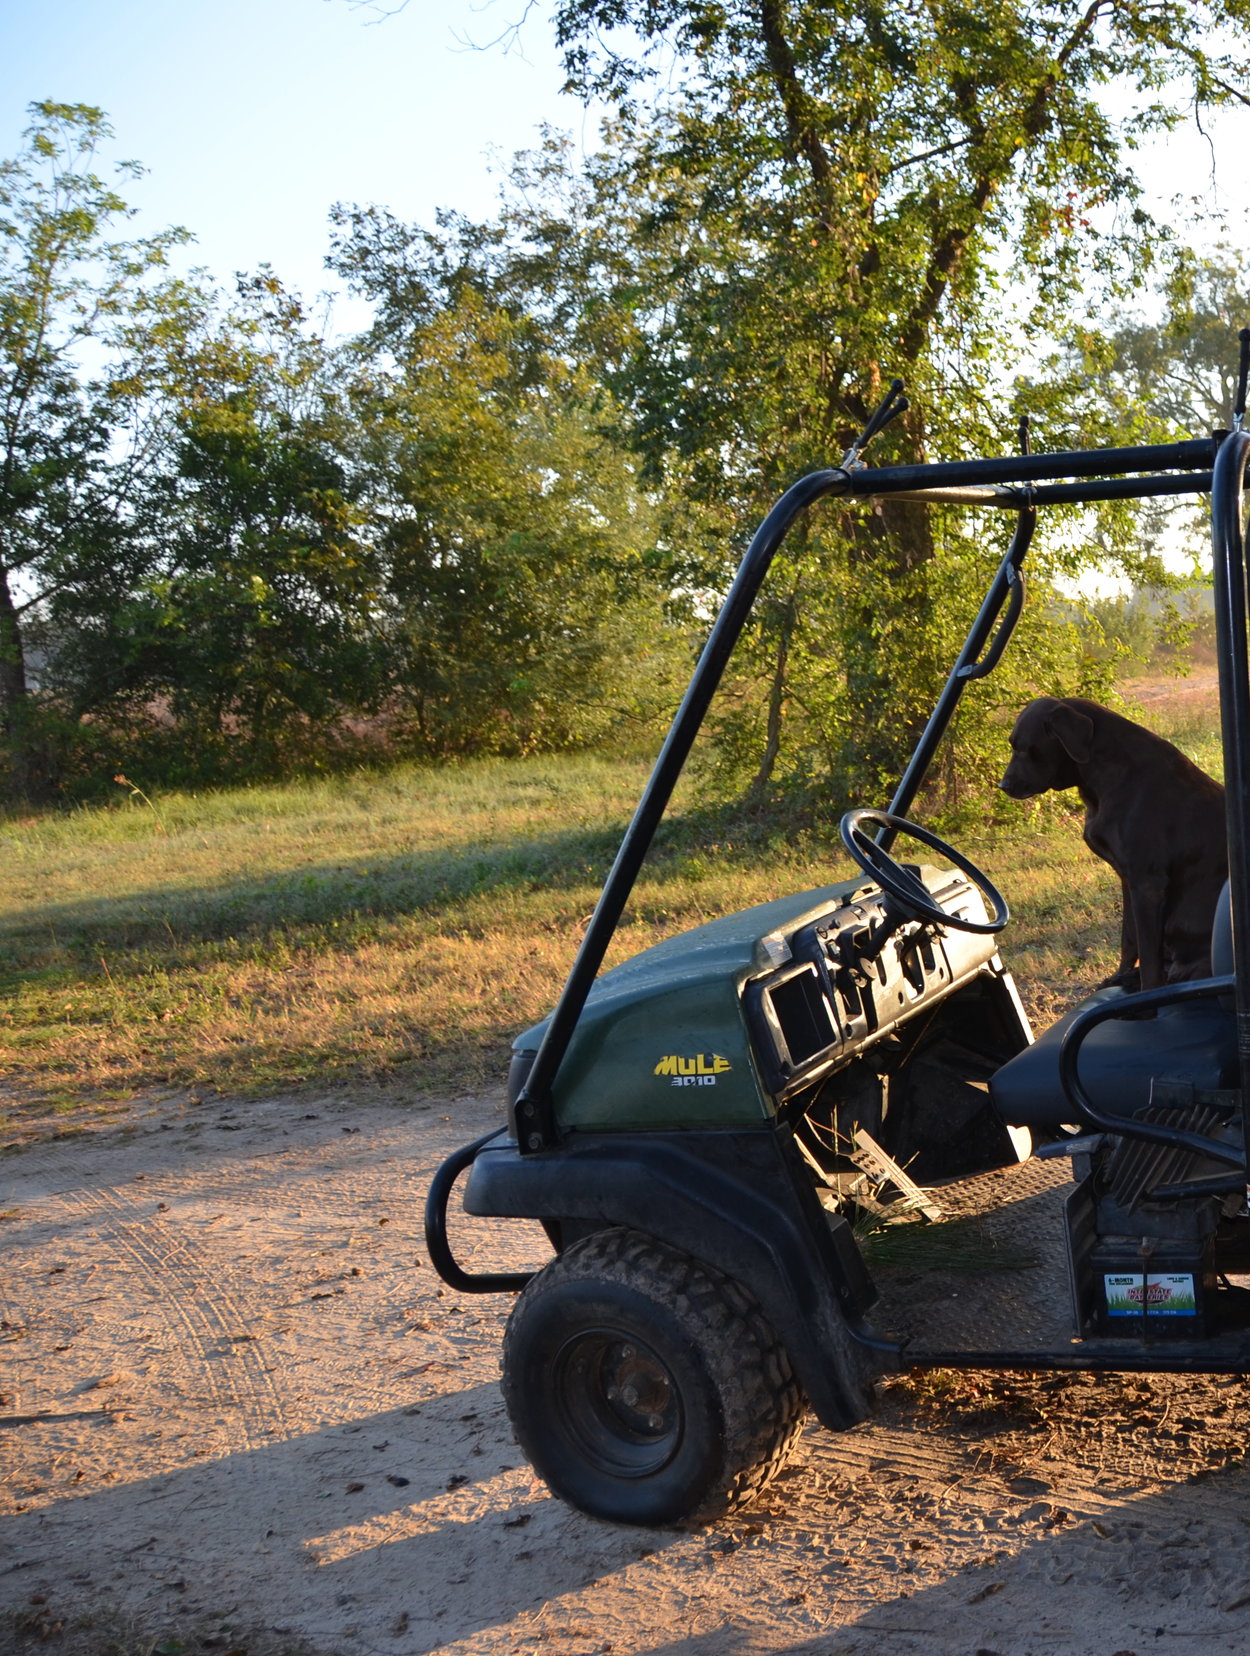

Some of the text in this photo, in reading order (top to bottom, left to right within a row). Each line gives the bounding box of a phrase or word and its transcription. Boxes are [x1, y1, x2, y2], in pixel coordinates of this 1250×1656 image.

[653, 1053, 733, 1076] MULE
[671, 1075, 716, 1087] 3010
[1128, 1287, 1172, 1296] INTESTATE
